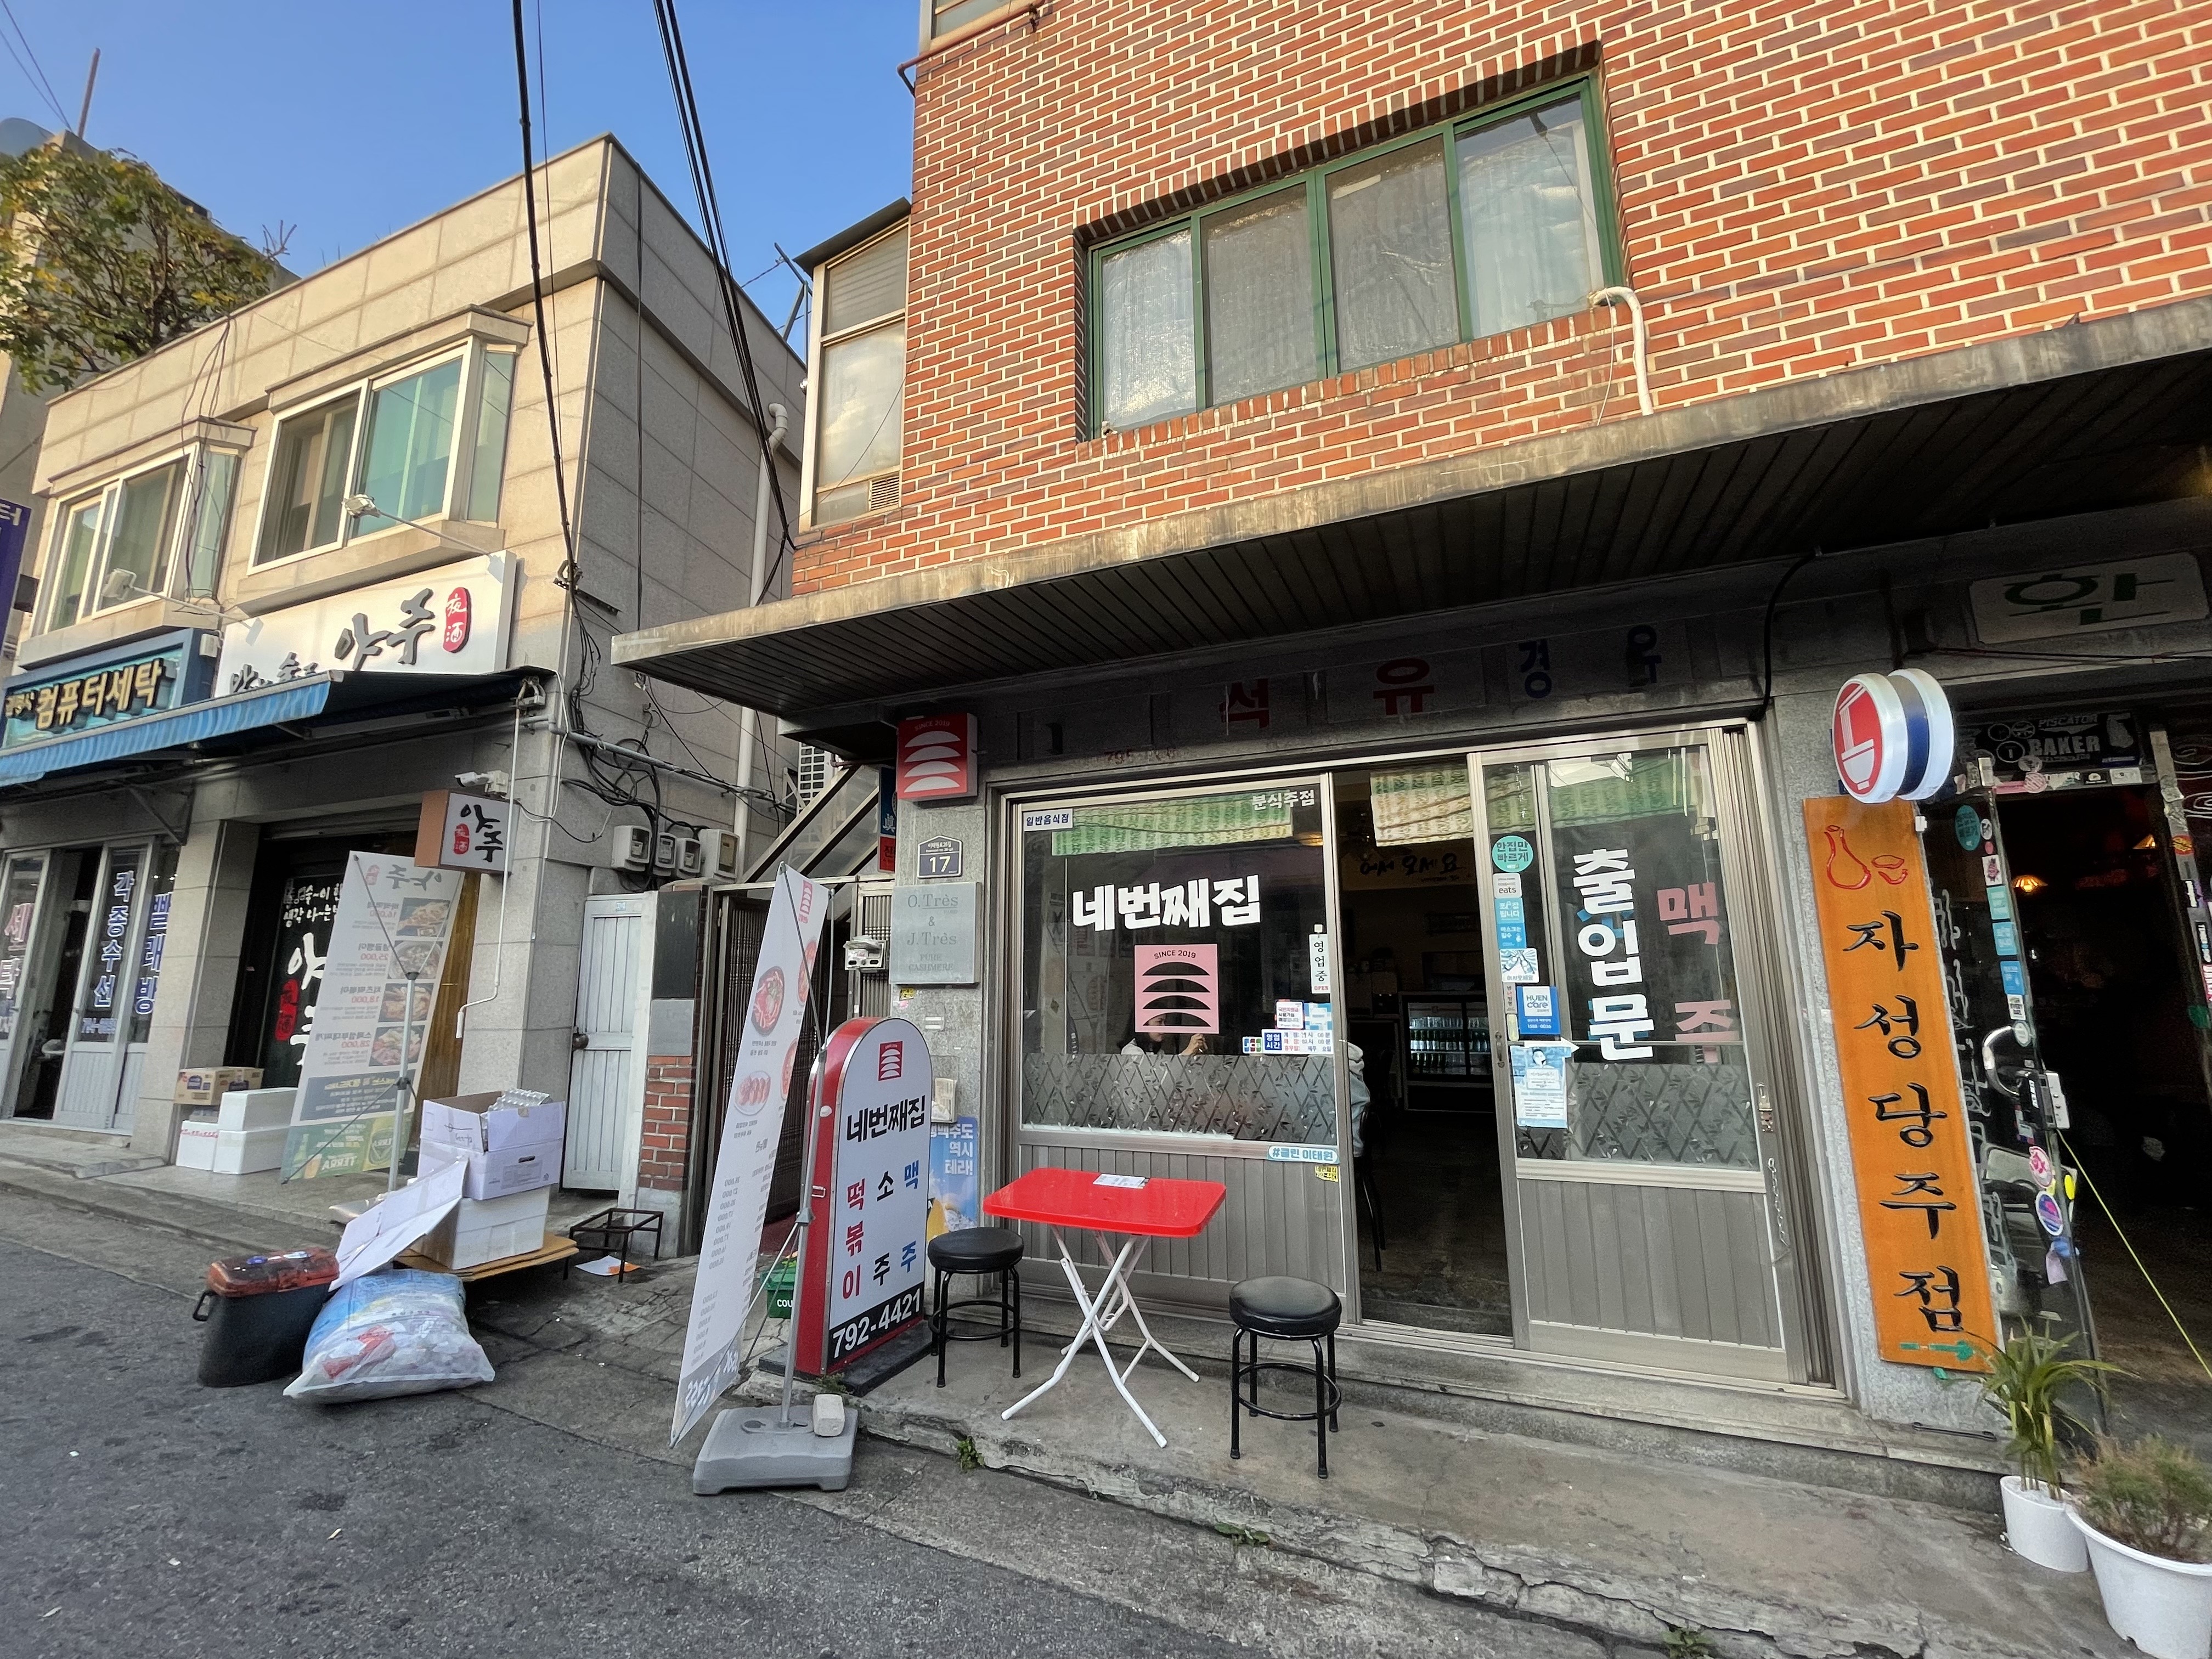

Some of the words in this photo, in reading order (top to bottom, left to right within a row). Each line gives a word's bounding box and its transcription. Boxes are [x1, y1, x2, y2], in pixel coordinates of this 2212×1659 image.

[36, 658, 161, 730] 컴퓨터세탁
[1025, 813, 1069, 826] 일반음식점
[1252, 789, 1314, 811] 분식주점
[929, 856, 950, 873] 17
[1497, 852, 1529, 862] 빠르게
[928, 916, 935, 927] &
[1073, 874, 1261, 932] 네번째집
[94, 870, 134, 1007] 각종수선
[1154, 950, 1176, 960] SINCE
[1178, 950, 1197, 959] 2019
[1572, 849, 1655, 1060] 출입문
[1314, 941, 1328, 982] 영업중
[1266, 1041, 1281, 1049] 시간
[847, 1096, 926, 1143] 네번째집
[1842, 910, 1964, 1332] 자성당주점
[945, 1159, 973, 1176] 테라!
[949, 1142, 974, 1158] 역시
[1302, 1149, 1333, 1161] 이태원
[873, 1171, 894, 1286] 소주
[900, 1160, 920, 1273] 맥주
[843, 1178, 865, 1299] 떡볶이
[833, 1288, 921, 1358] 792-4421
